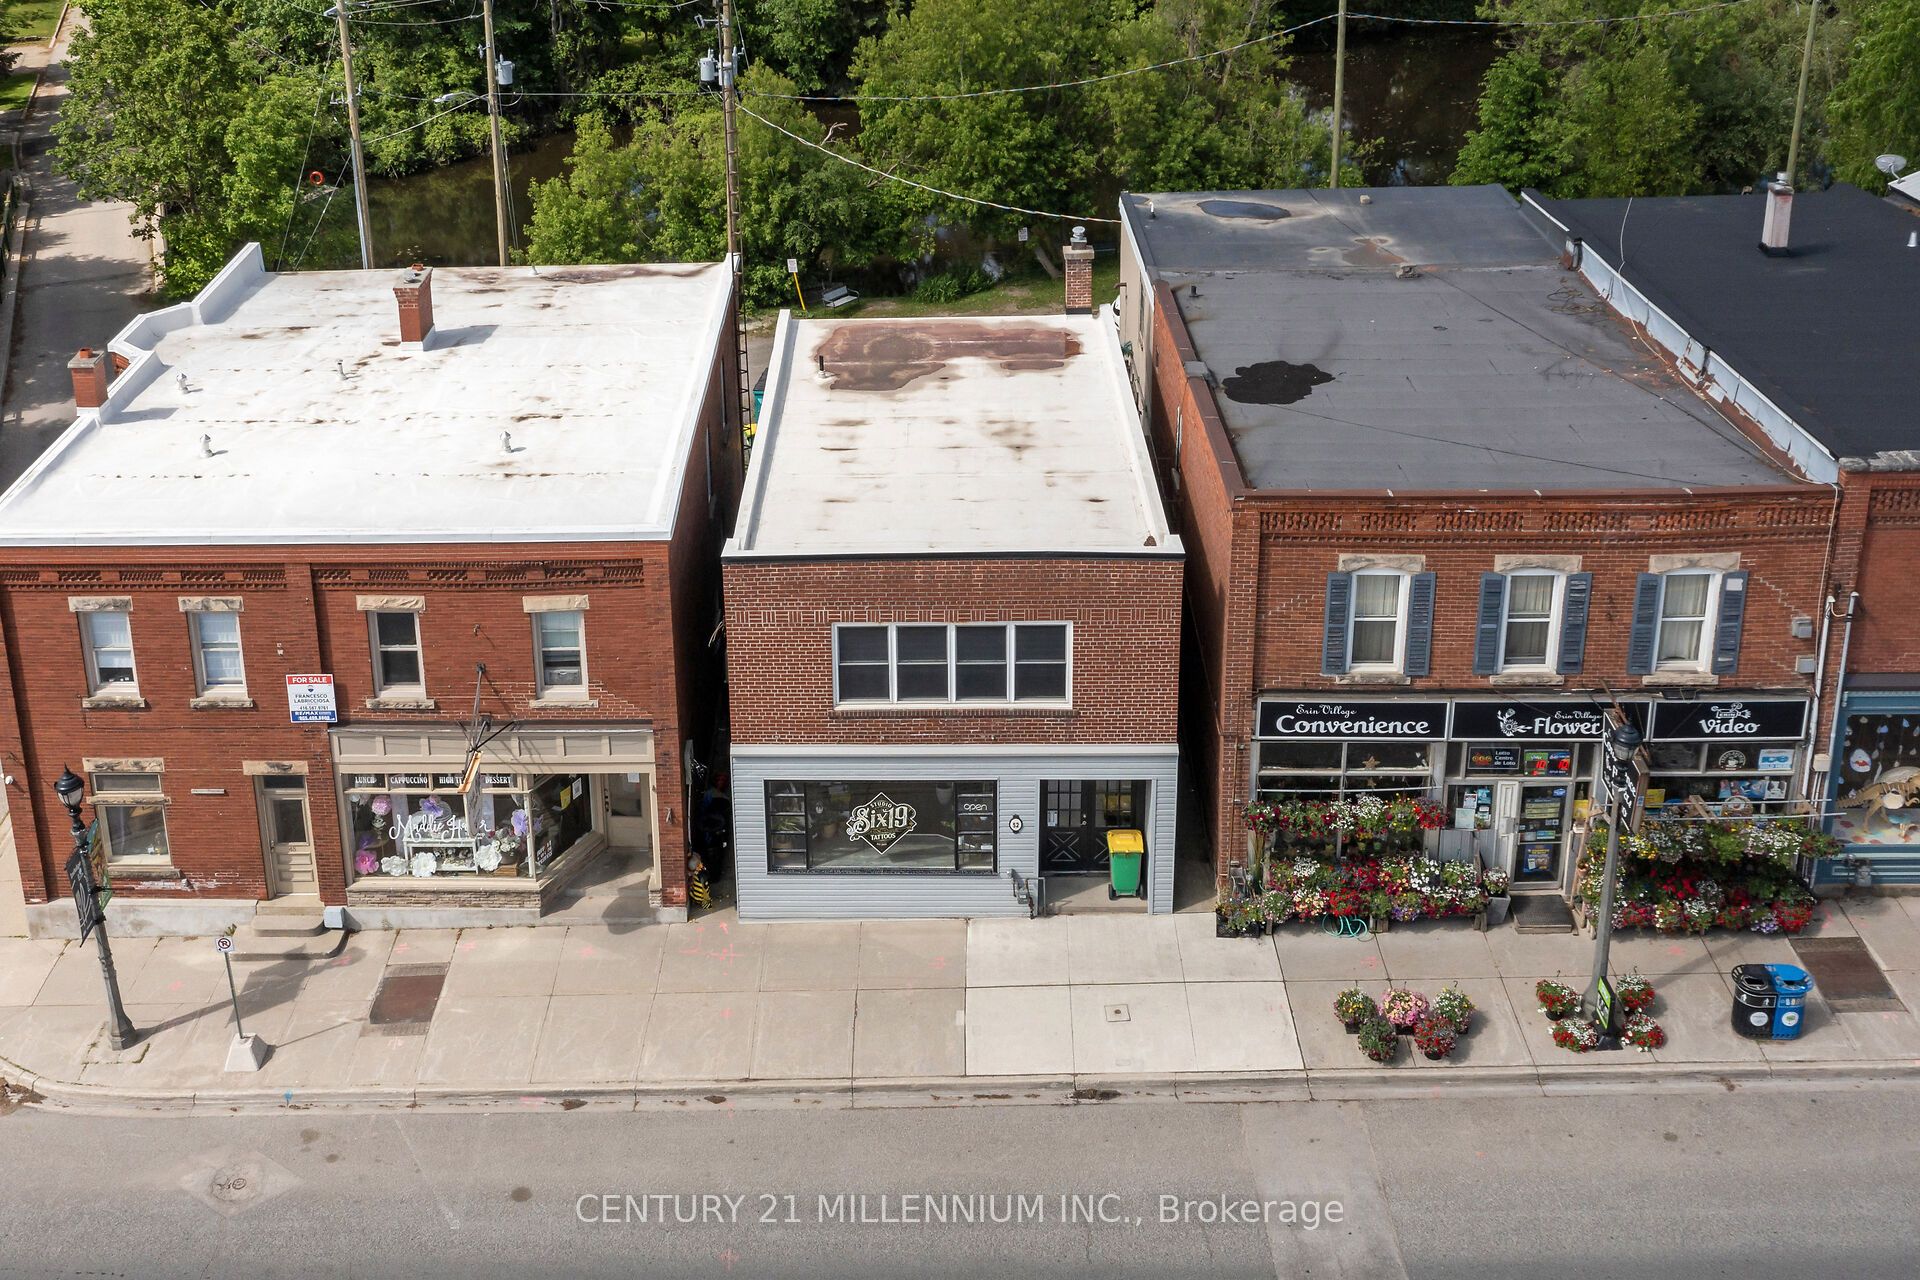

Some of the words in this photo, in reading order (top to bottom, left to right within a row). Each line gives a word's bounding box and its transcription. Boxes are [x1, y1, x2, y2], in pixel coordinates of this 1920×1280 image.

[1295, 703, 1319, 715] Erin
[1318, 703, 1357, 718] Village
[1553, 709, 1573, 720] Erin
[1276, 714, 1431, 734] Convenience
[1698, 718, 1761, 734] Video
[355, 776, 375, 784] LUNCH
[390, 776, 428, 784] CAPPUCCINO
[439, 776, 453, 784] HIGH
[485, 776, 511, 784] DESSERT
[870, 801, 893, 809] STUDIO
[963, 803, 988, 812] open
[852, 805, 908, 834] Six19
[871, 832, 896, 841] TATTOOS
